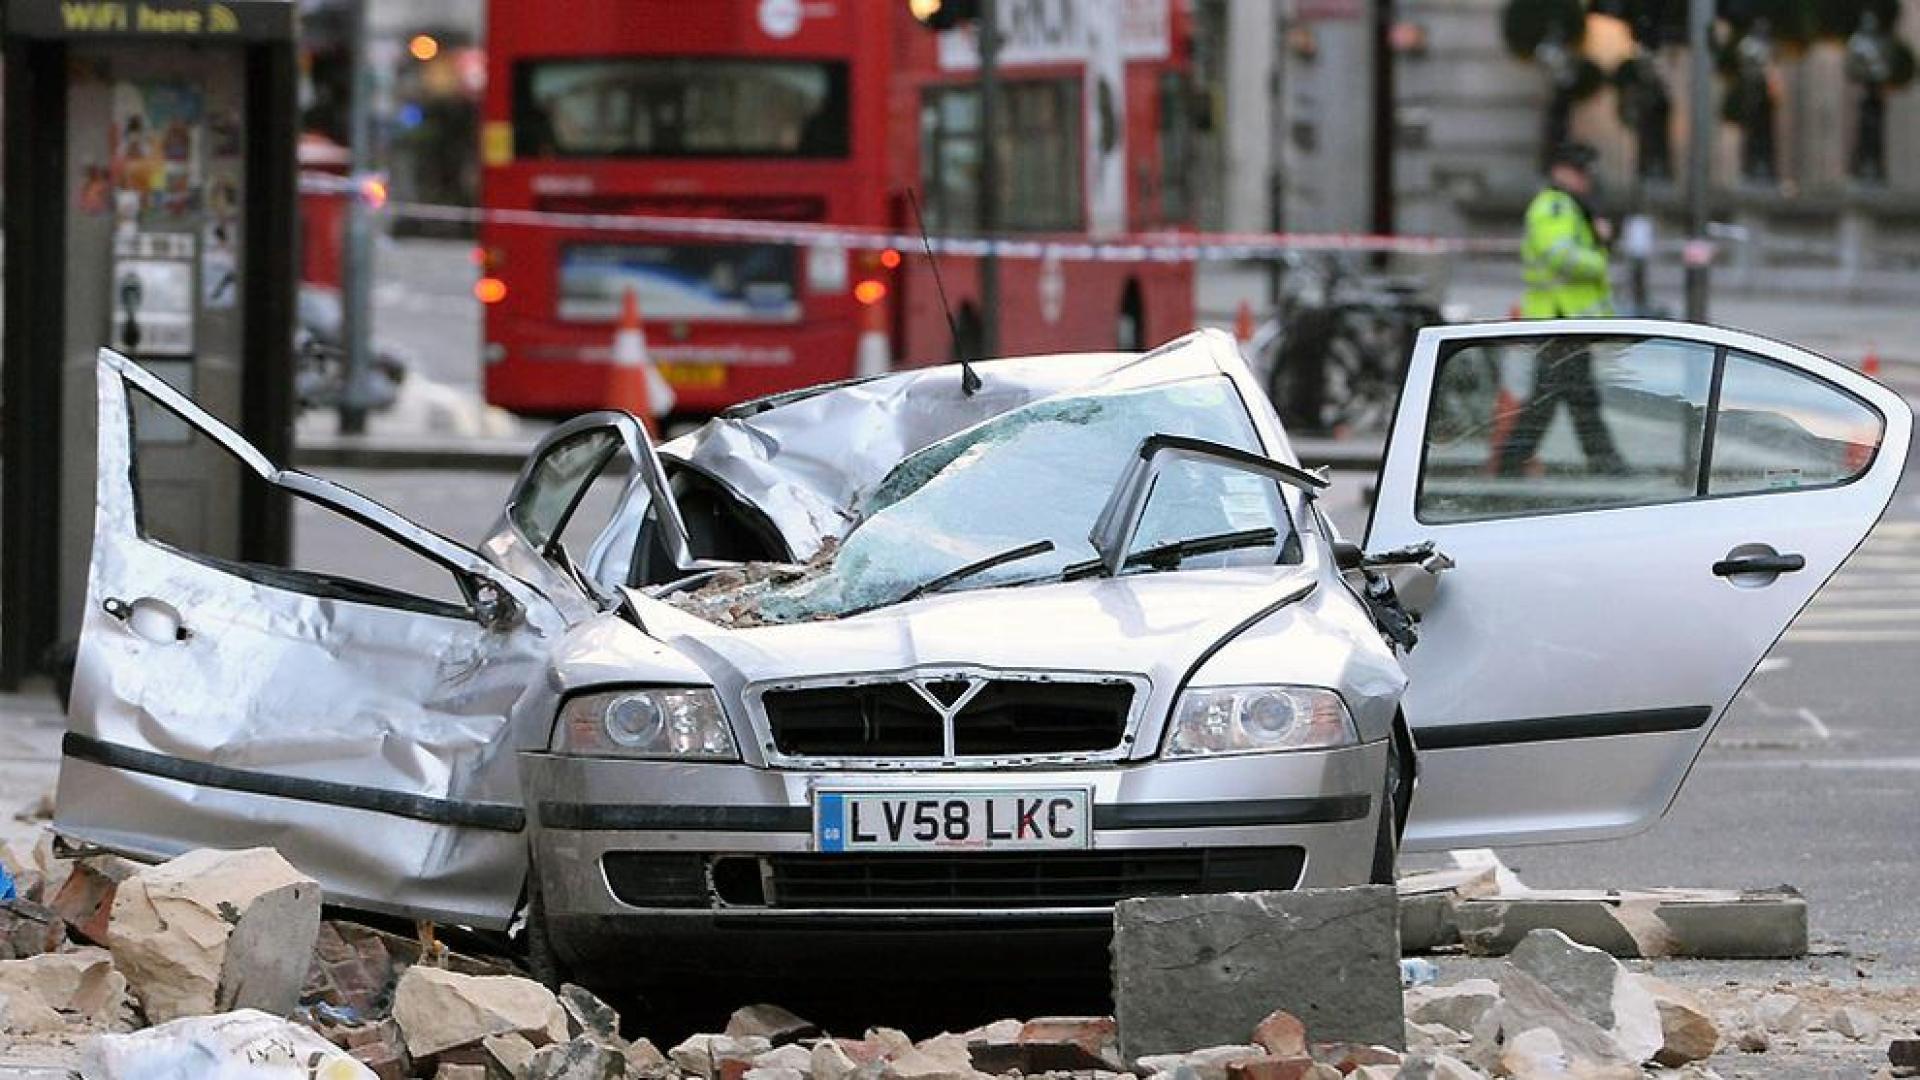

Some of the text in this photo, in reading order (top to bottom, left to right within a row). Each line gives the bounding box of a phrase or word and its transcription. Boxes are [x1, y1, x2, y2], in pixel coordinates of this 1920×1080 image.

[137, 4, 201, 32] here
[851, 798, 1074, 842] LV58 LKC
